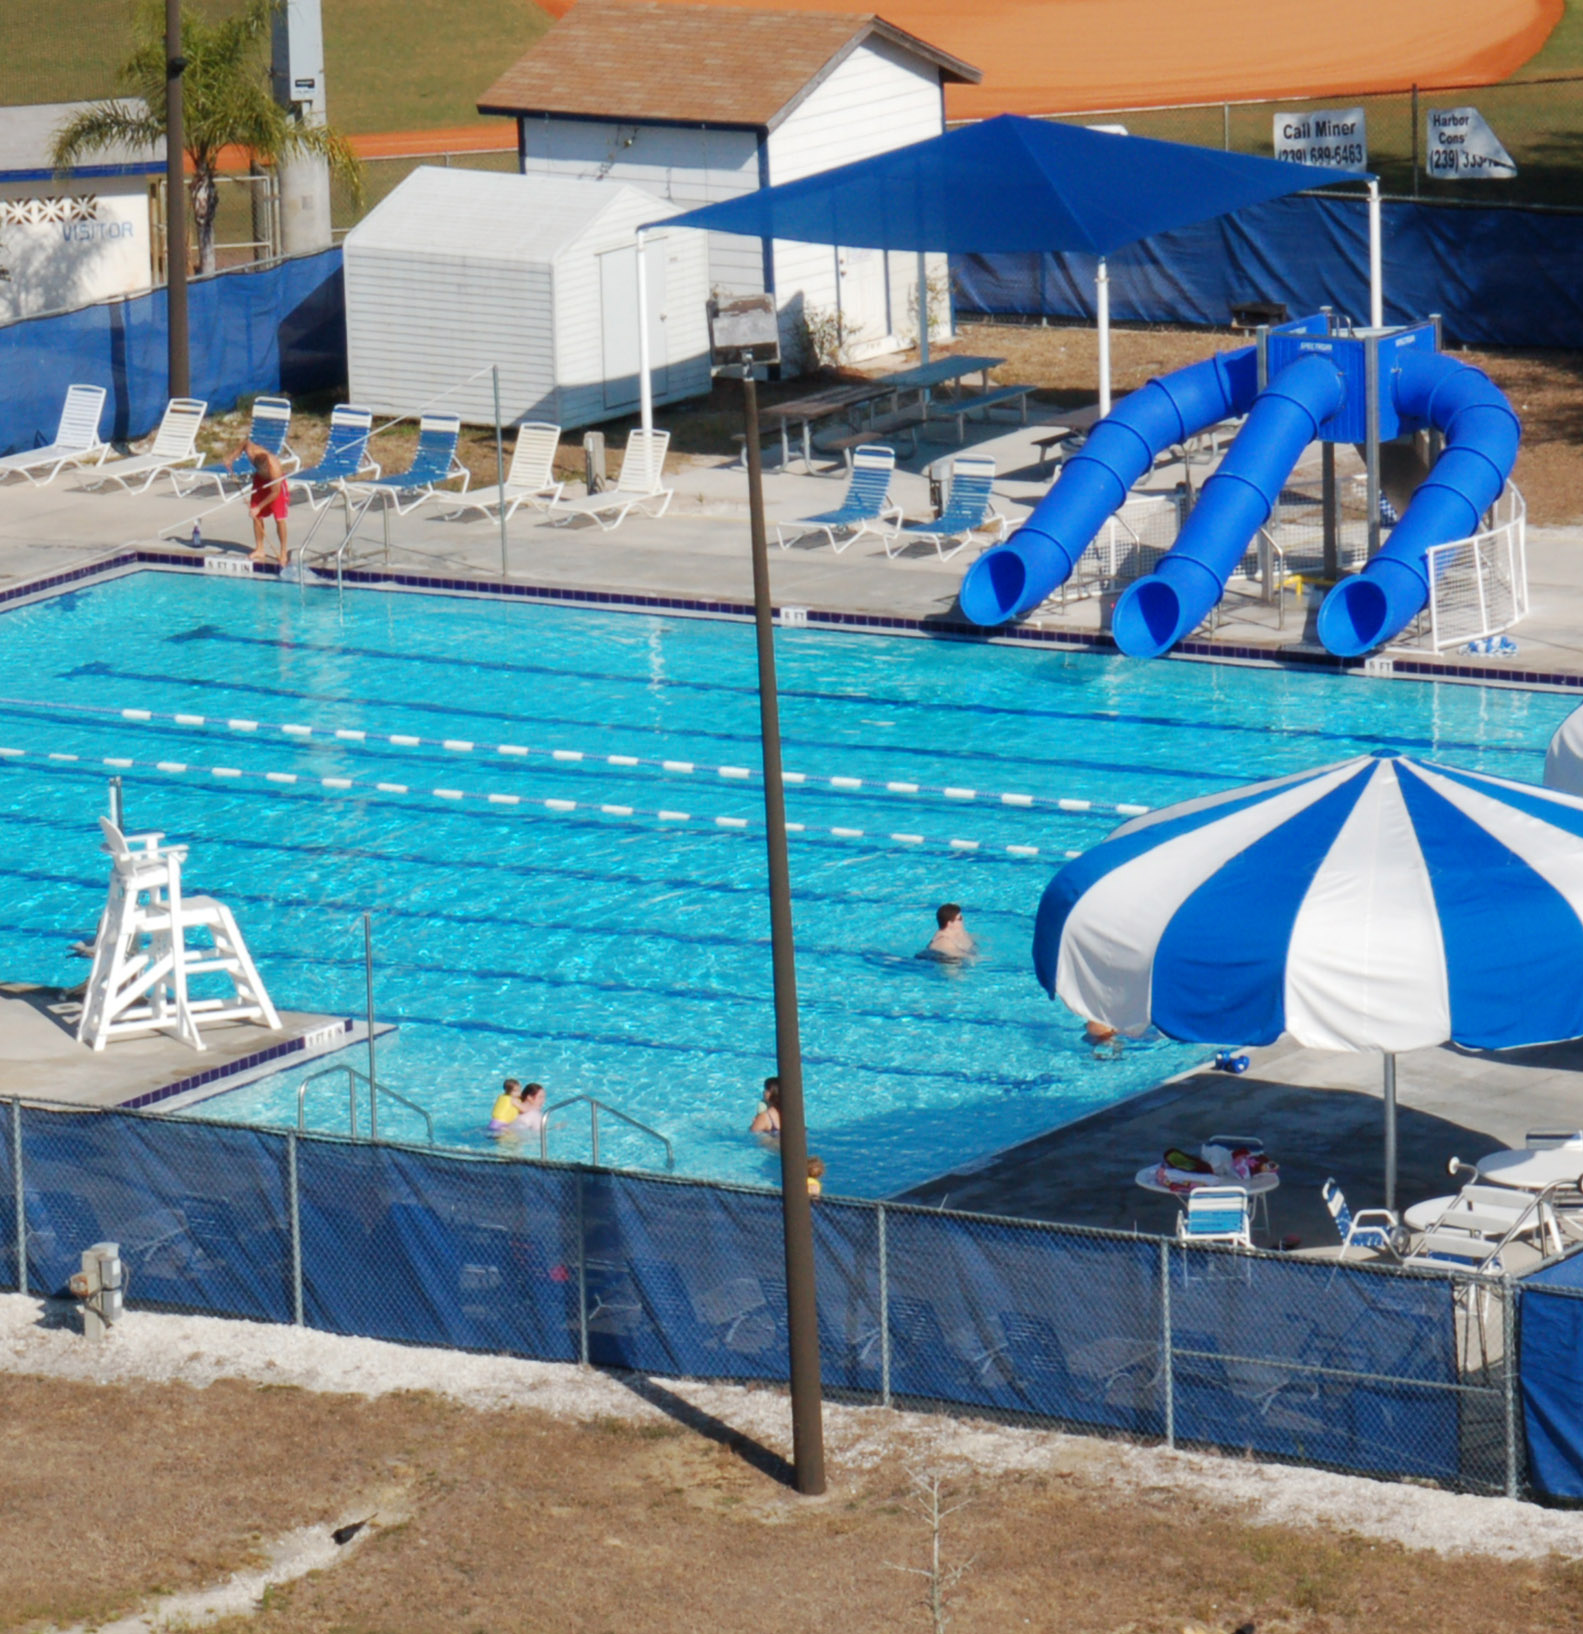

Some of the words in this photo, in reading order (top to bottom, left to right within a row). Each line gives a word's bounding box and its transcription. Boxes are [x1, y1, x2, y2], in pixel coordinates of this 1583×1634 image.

[1283, 122, 1310, 139] Call
[1314, 120, 1356, 137] Miner
[1433, 114, 1470, 127] Harbor
[1439, 132, 1467, 145] Cons
[1430, 149, 1459, 174] (239)
[63, 222, 134, 242] VISITOR
